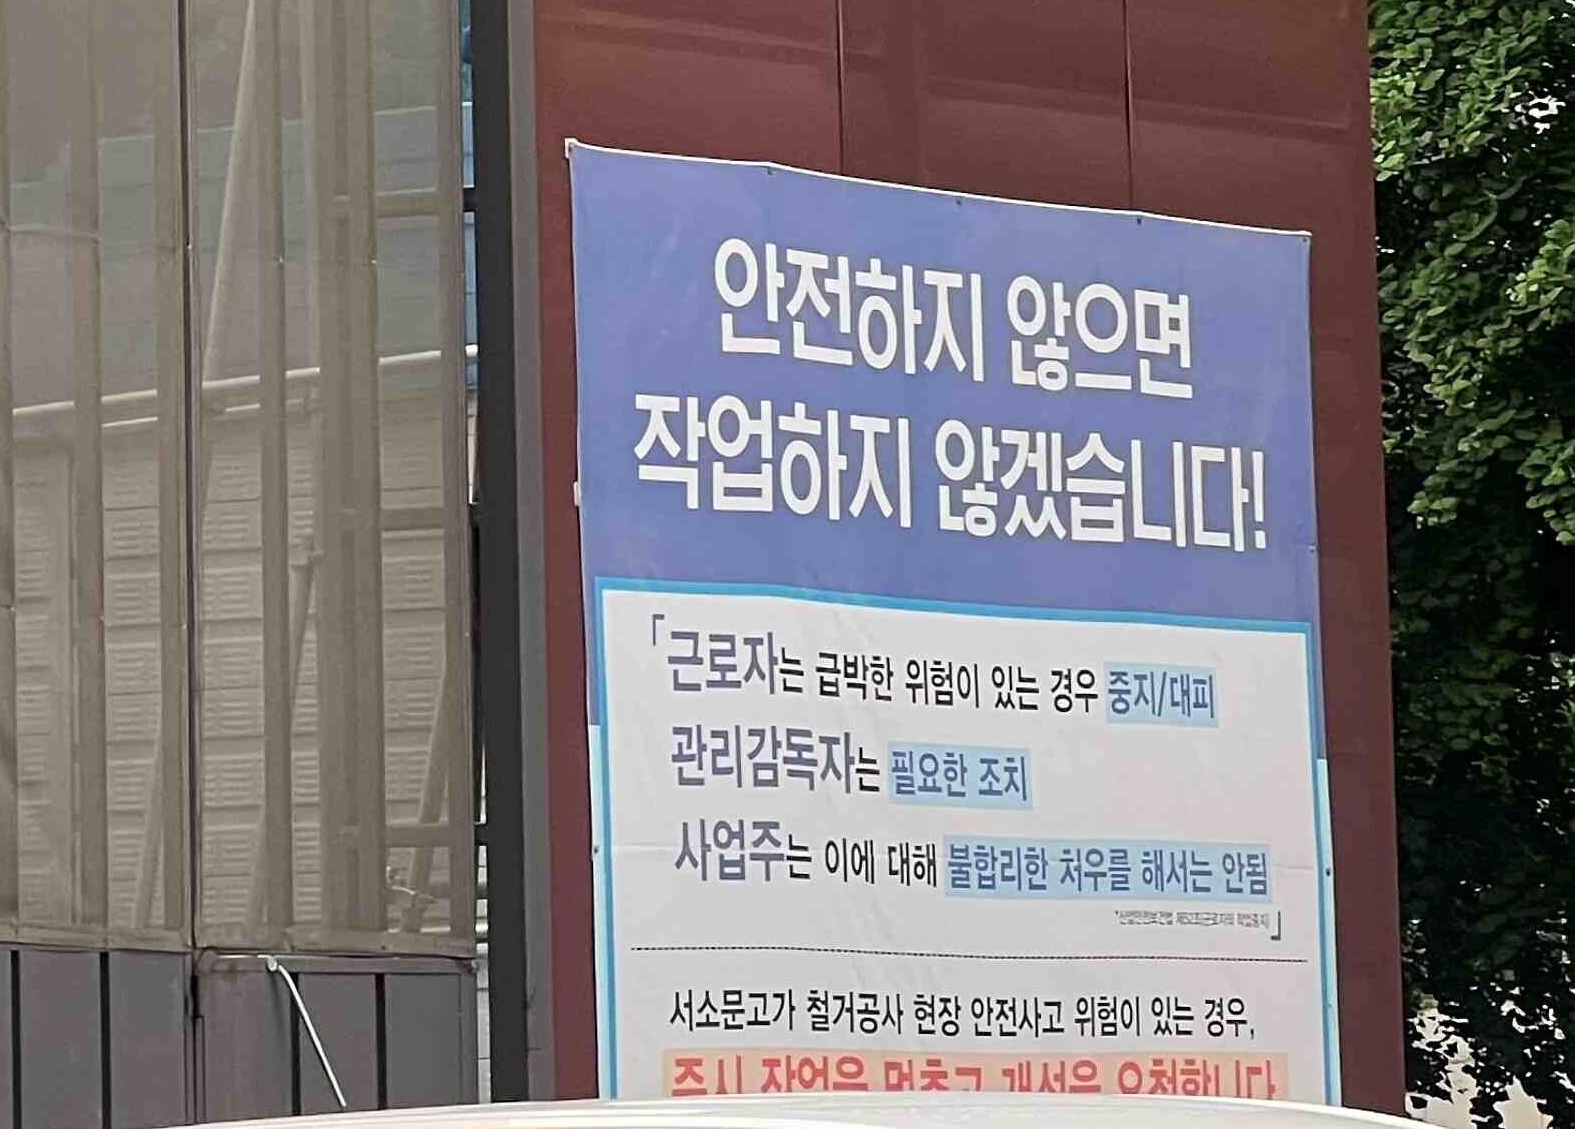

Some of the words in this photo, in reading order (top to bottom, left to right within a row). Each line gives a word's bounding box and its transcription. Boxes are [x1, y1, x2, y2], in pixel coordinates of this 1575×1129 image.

[715, 239, 983, 381] 안전하지
[1007, 276, 1192, 398] 않으면
[634, 395, 910, 527] 작업하지
[936, 420, 1265, 551] 않겠습니다!
[816, 653, 893, 701] 급박한
[906, 660, 979, 708] 위험이
[992, 666, 1039, 710] 있는
[1051, 669, 1098, 712] 경우
[1108, 673, 1215, 718] 중지/대피
[672, 725, 880, 794] 관리감독자는
[892, 751, 967, 797] 필요한
[979, 757, 1027, 801] 조치
[675, 819, 812, 881] 사업주는
[825, 838, 874, 884] 이에
[888, 842, 936, 887] 대해
[948, 844, 1048, 891] 불합리한
[1059, 849, 1131, 891] 처우를
[1142, 850, 1212, 893] 해서는
[1222, 852, 1267, 895] 안됨
[670, 989, 795, 1031] 서소문고가
[807, 990, 903, 1034] 철거공사
[914, 994, 961, 1036] 현장
[971, 997, 1064, 1037] 안전사고
[1075, 996, 1140, 1037] 위험이
[1152, 997, 1194, 1035] 있는
[1205, 998, 1254, 1038] 경우,
